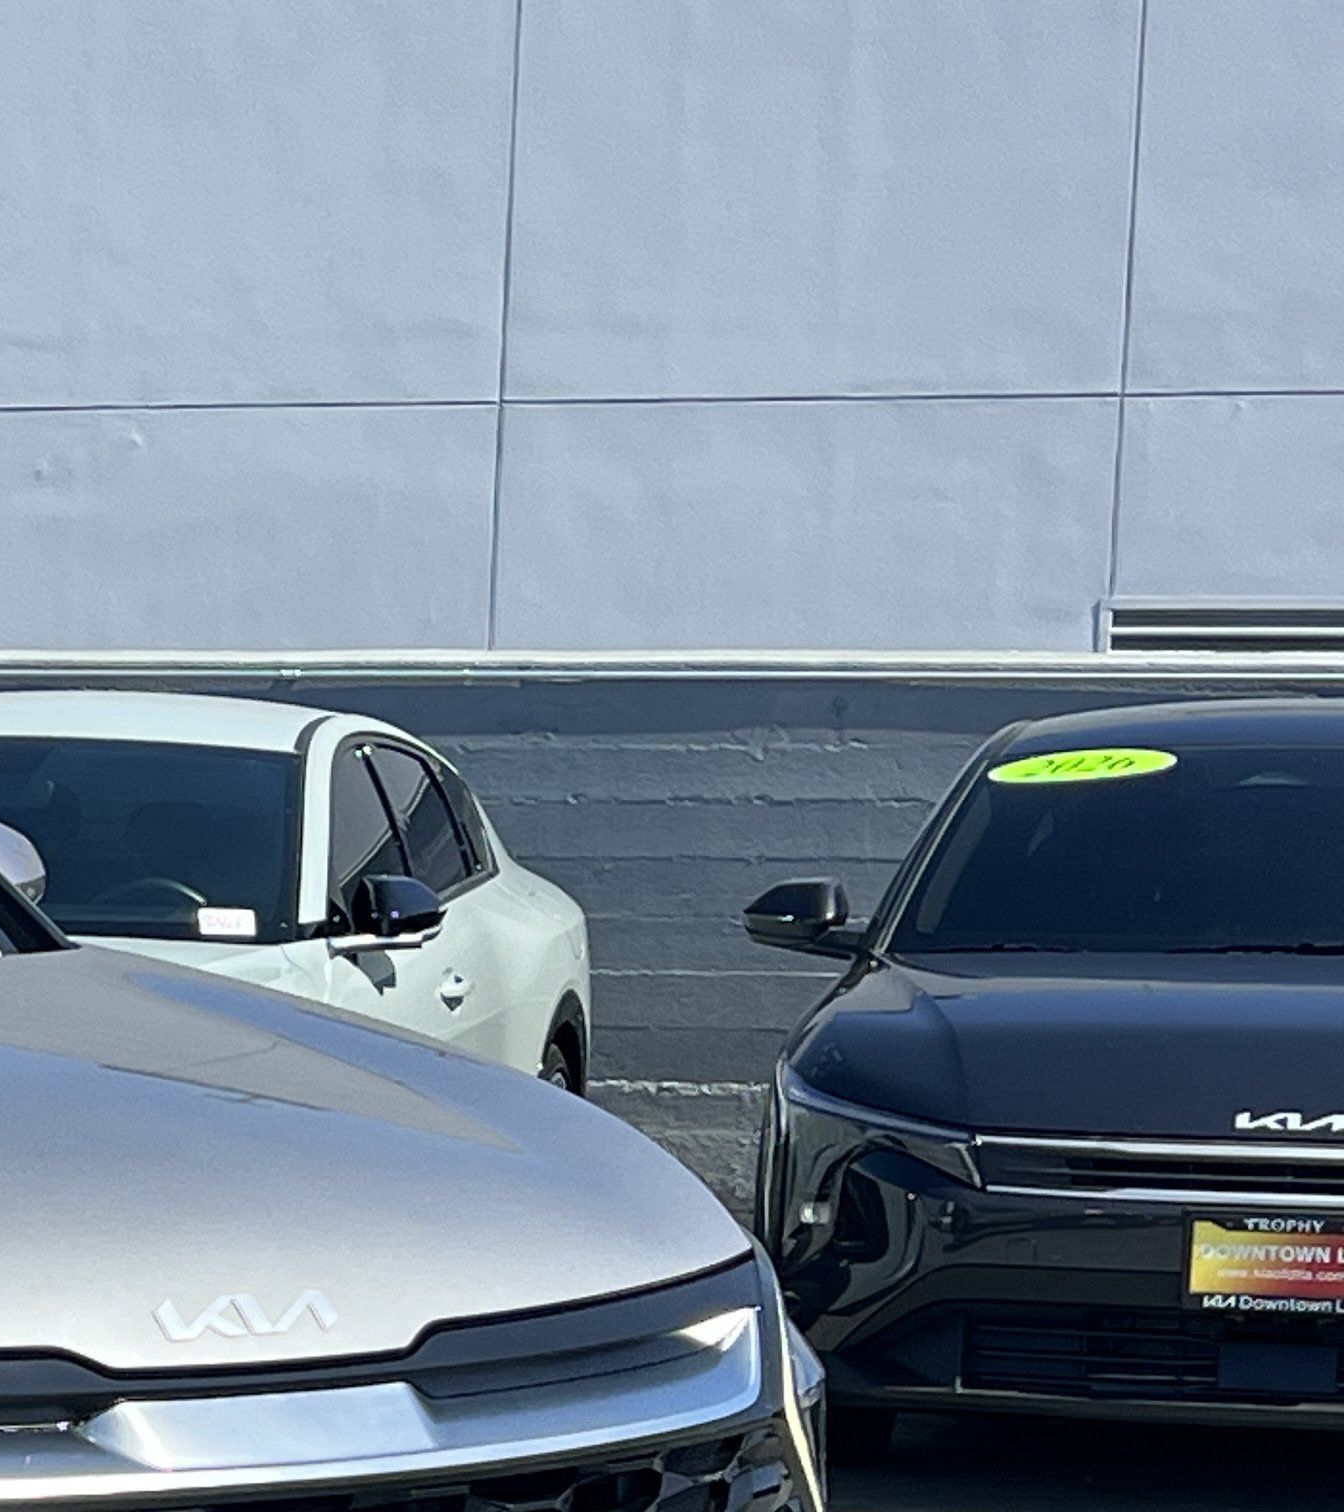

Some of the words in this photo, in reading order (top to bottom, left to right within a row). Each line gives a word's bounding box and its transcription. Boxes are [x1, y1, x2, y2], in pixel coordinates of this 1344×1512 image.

[1244, 1217, 1326, 1233] TROPHY
[1200, 1243, 1331, 1263] DOWNTOWN
[150, 1289, 338, 1343] KIA
